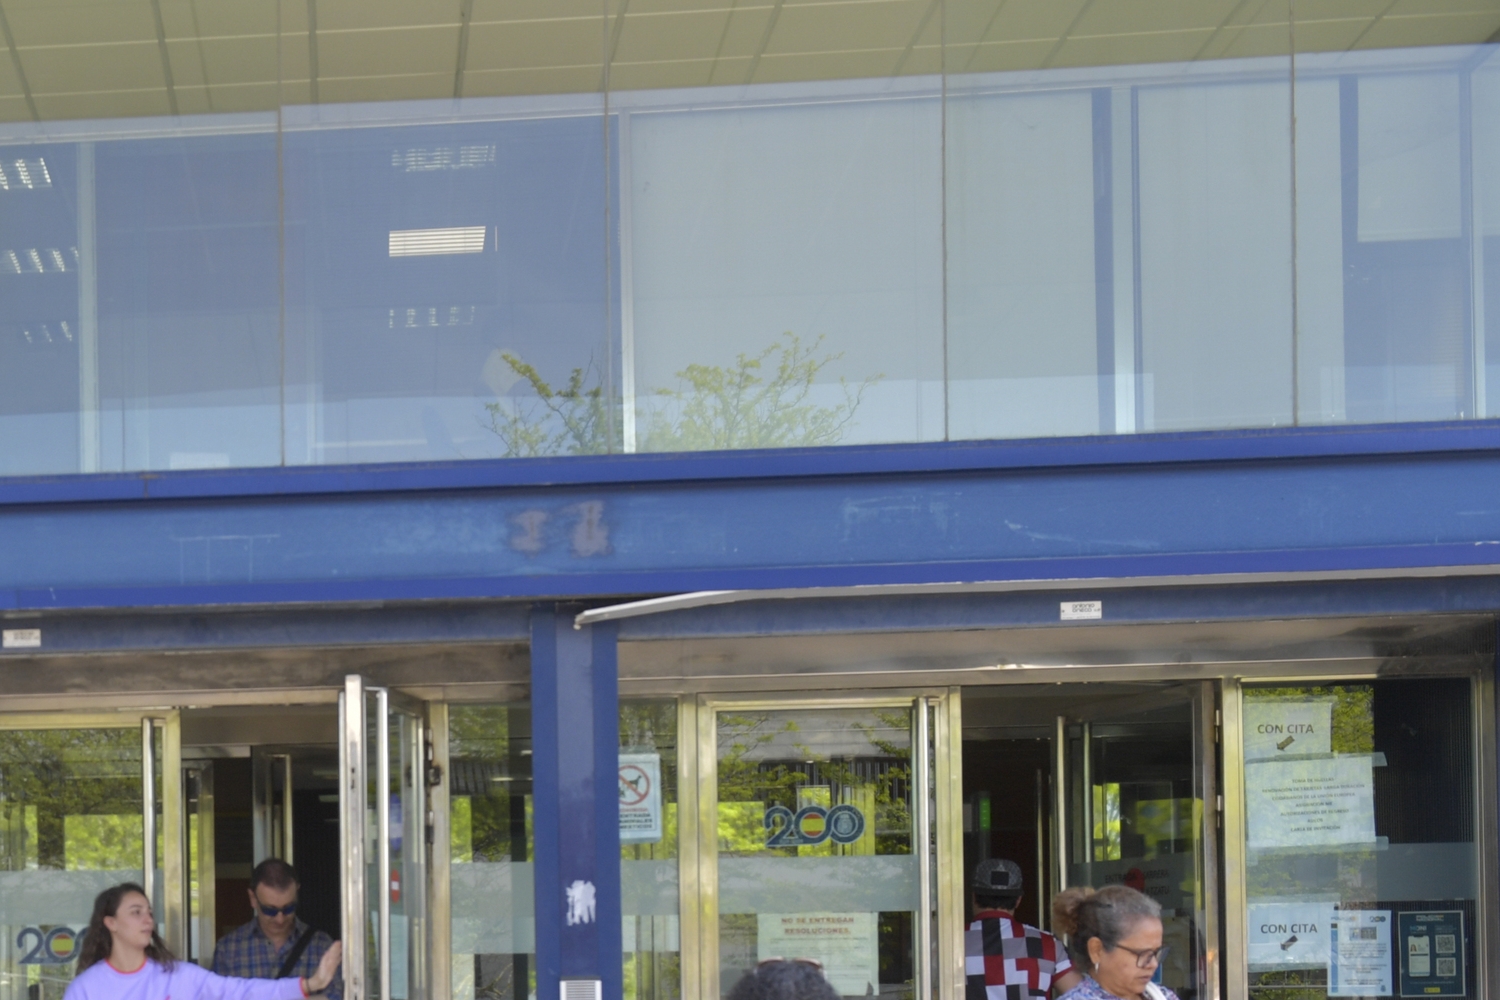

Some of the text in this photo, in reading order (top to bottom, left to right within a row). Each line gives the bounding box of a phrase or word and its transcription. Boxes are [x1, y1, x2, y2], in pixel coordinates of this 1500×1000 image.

[1257, 724, 1314, 734] CON CITA
[1260, 923, 1318, 934] CON CITA
